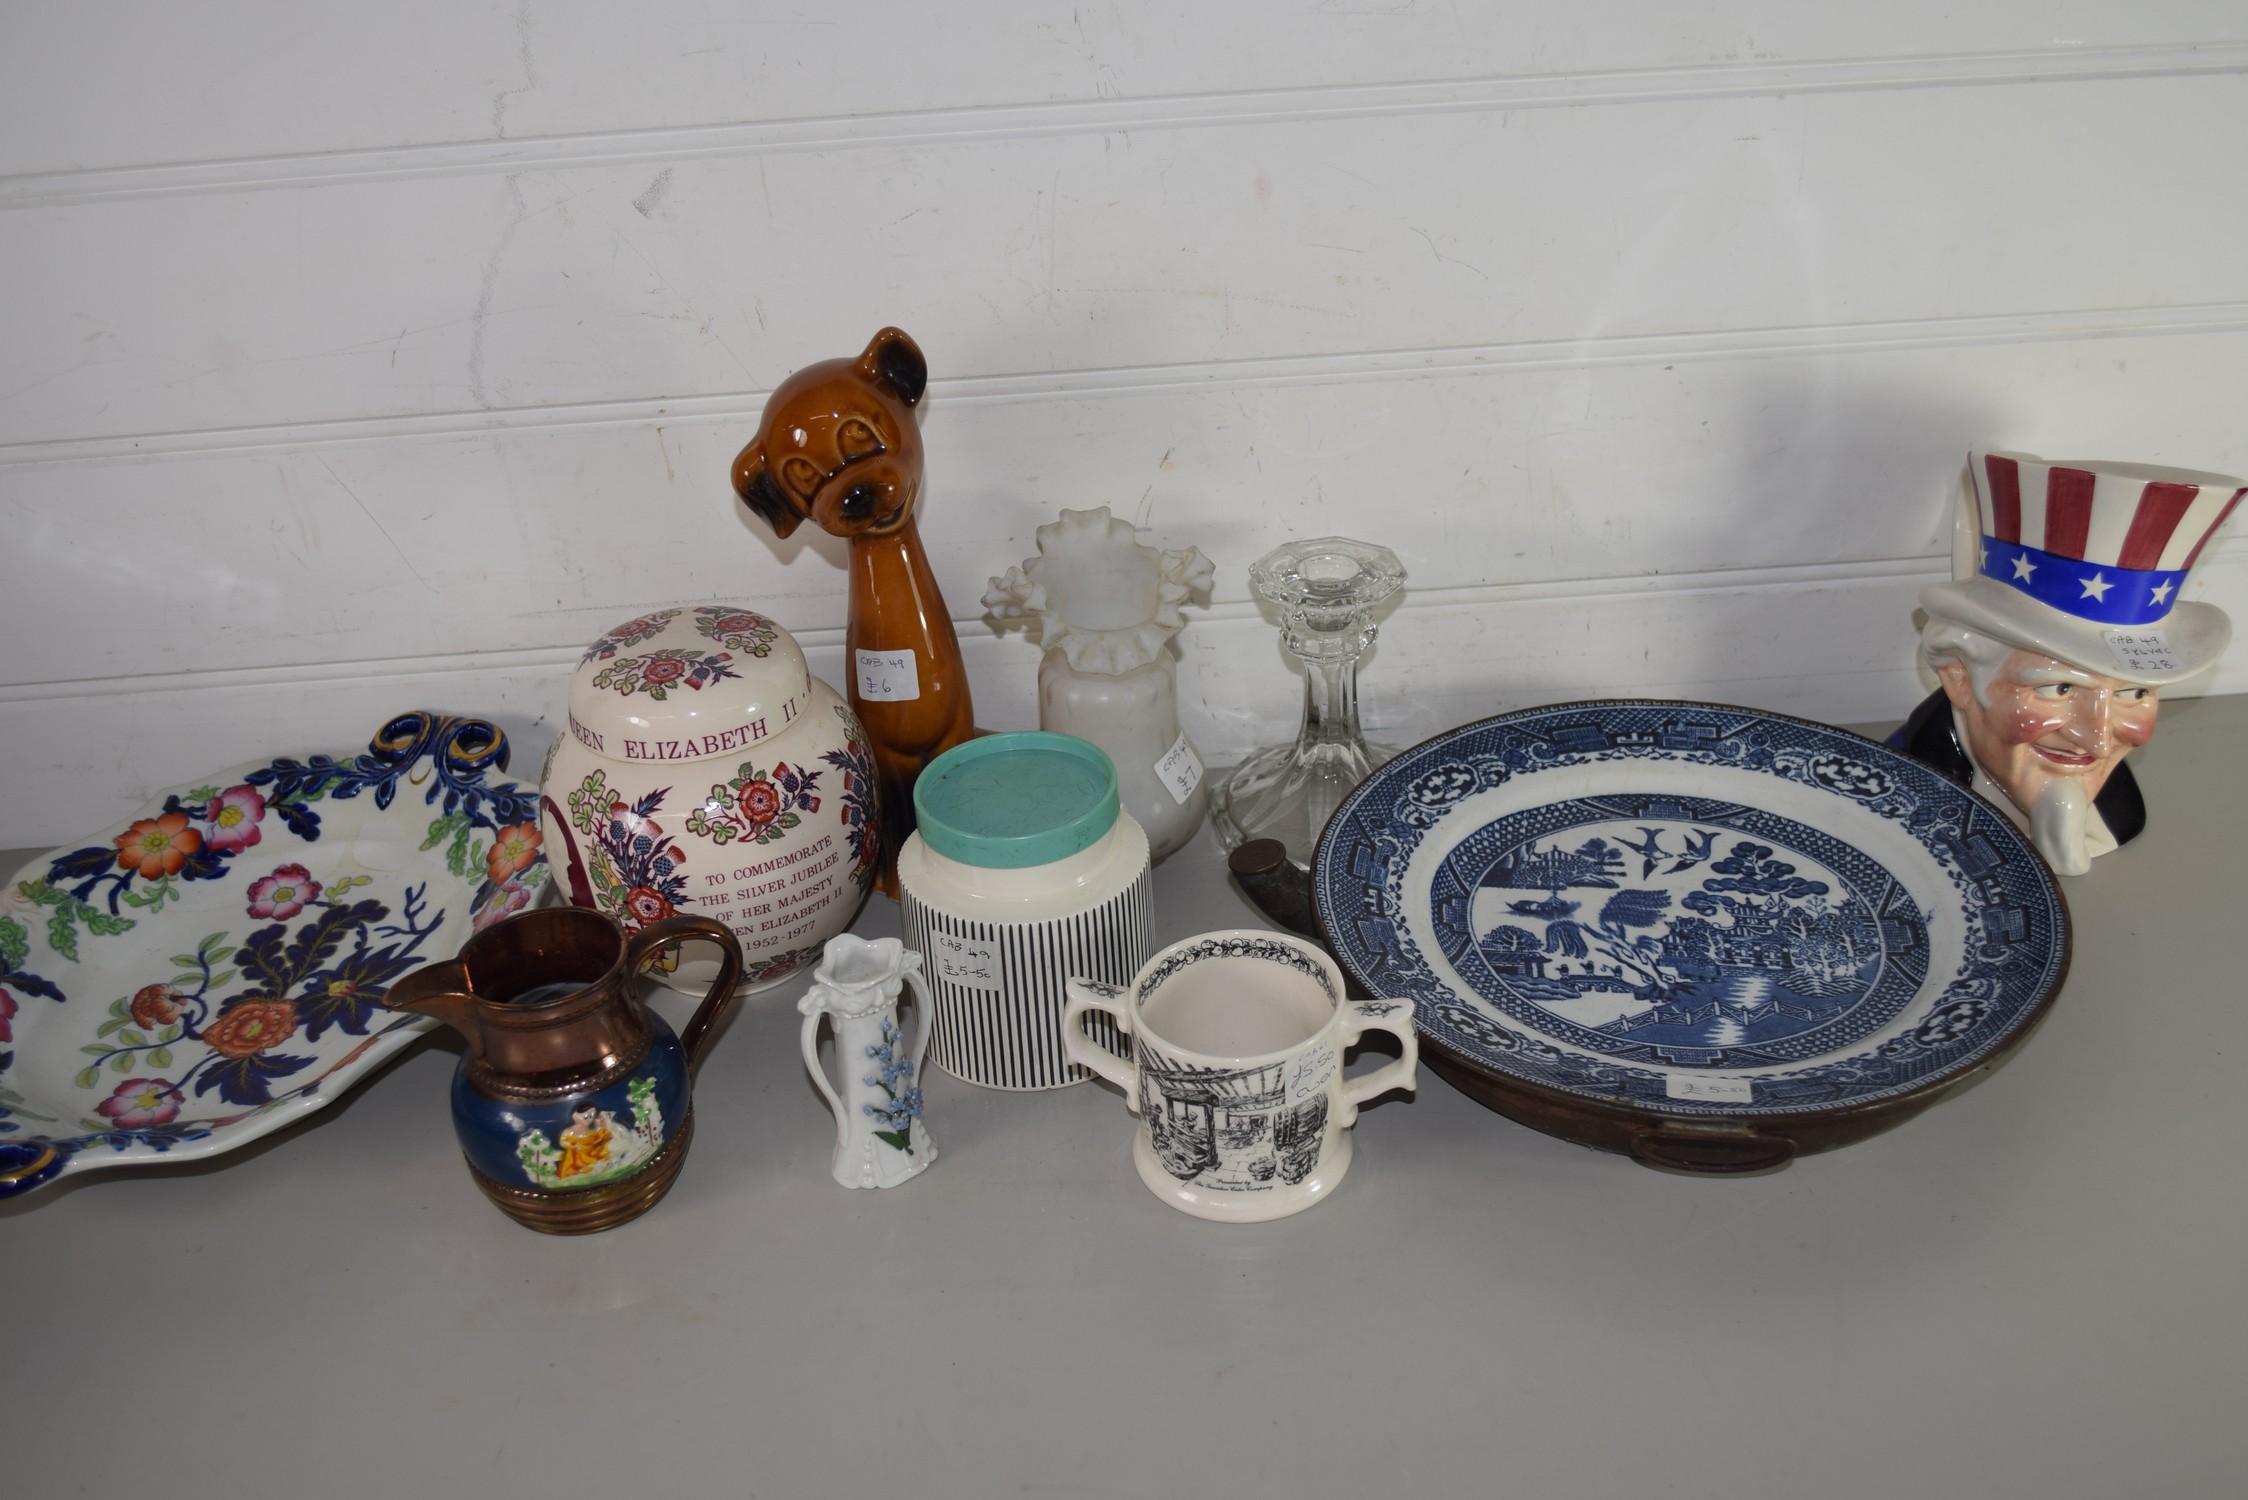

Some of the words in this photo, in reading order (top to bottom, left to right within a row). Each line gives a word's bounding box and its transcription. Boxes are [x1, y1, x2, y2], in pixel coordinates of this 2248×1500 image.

[860, 656, 884, 667] CAB
[888, 659, 905, 669] 49
[2110, 635, 2134, 645] CAB
[2140, 636, 2159, 646] 49
[623, 717, 769, 760] ELIZABETH
[699, 892, 730, 907] THE
[737, 879, 786, 901] SILVER
[790, 852, 839, 885] JUBILEE
[705, 873, 726, 887] TO
[733, 835, 833, 881] COMMEMORATE
[715, 910, 735, 923] OF
[742, 904, 771, 919] HER
[778, 875, 835, 910] MAJESTY
[761, 898, 831, 932] ELIZABETH
[834, 887, 843, 900] II
[940, 937, 962, 952] CAB
[968, 948, 990, 959] 49
